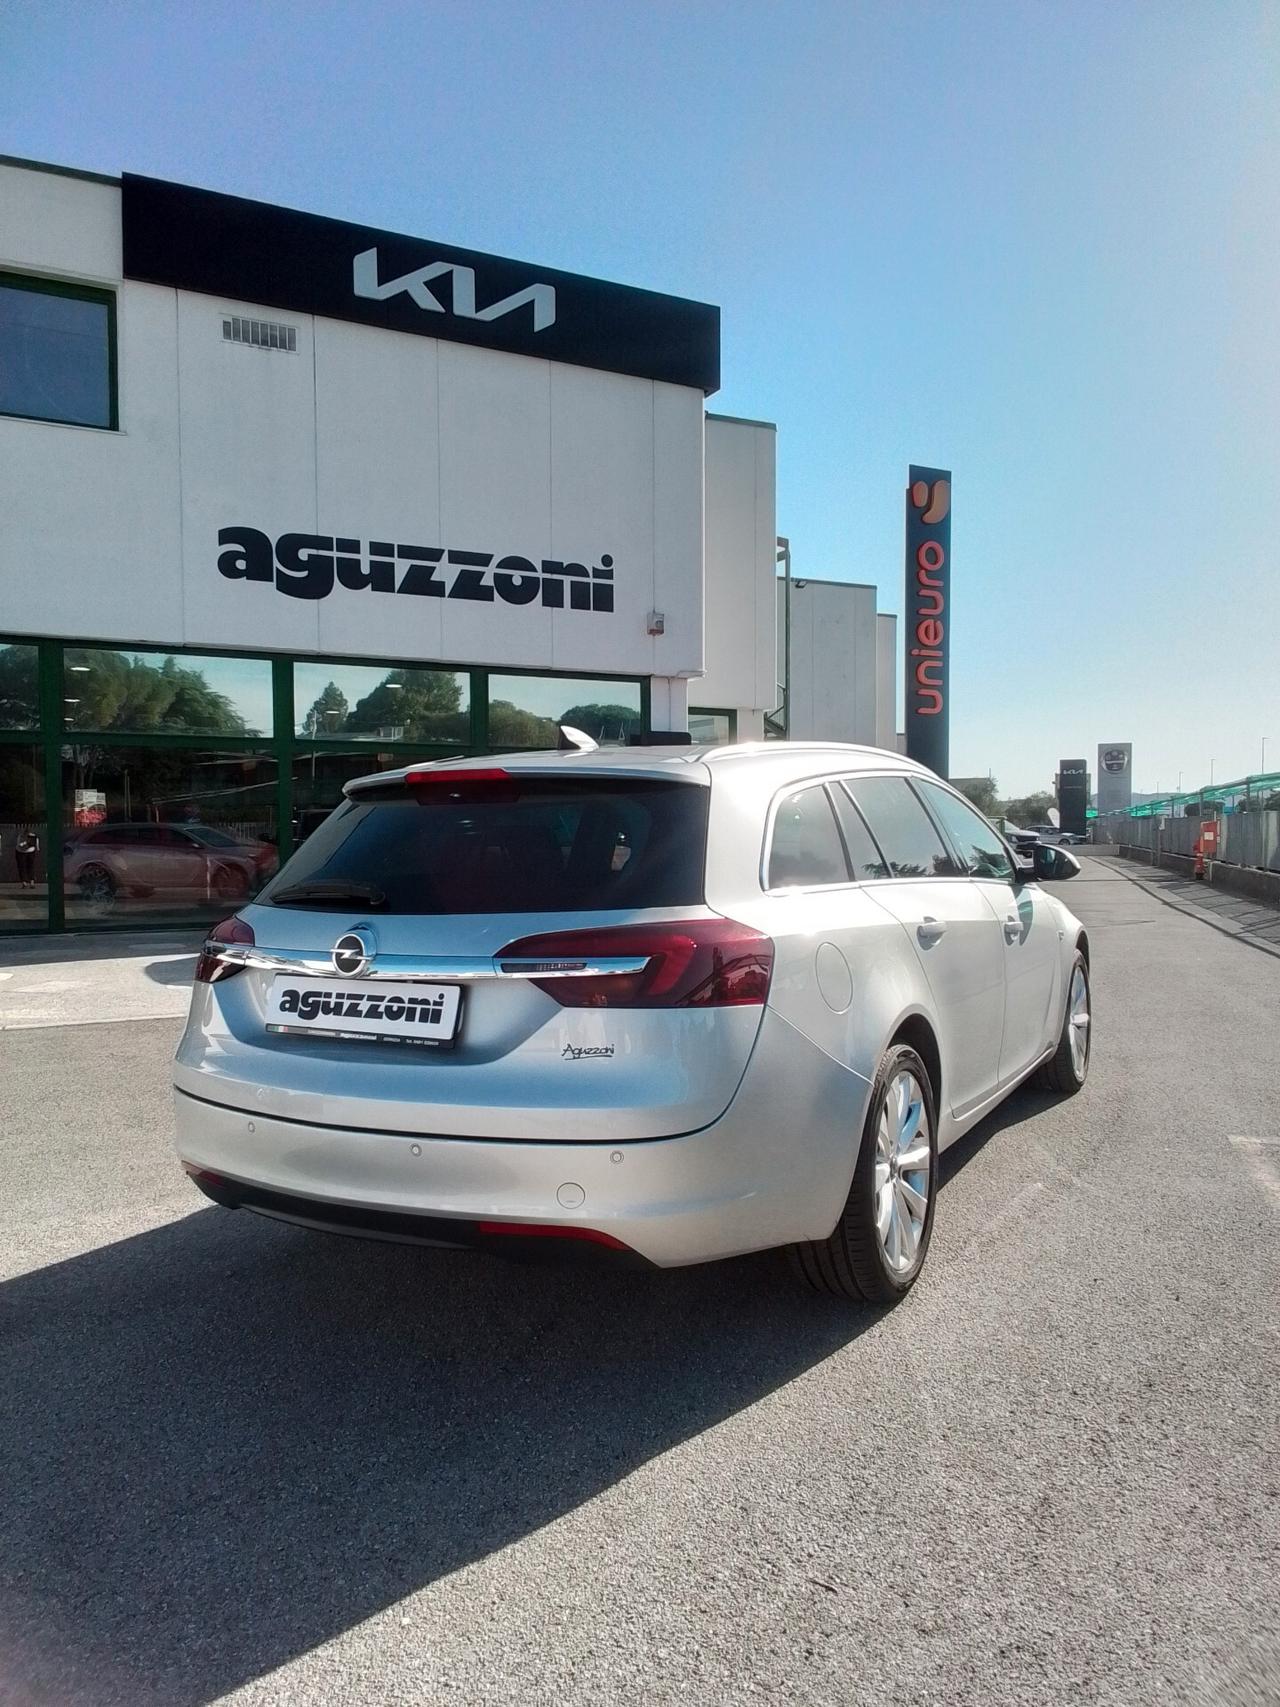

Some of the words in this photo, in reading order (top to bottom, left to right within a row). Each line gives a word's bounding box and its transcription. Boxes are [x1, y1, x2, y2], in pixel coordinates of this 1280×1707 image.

[352, 246, 556, 332] KIA
[217, 526, 614, 613] aguzzoni
[911, 540, 944, 715] unieuro
[278, 988, 444, 1025] aguzzoni
